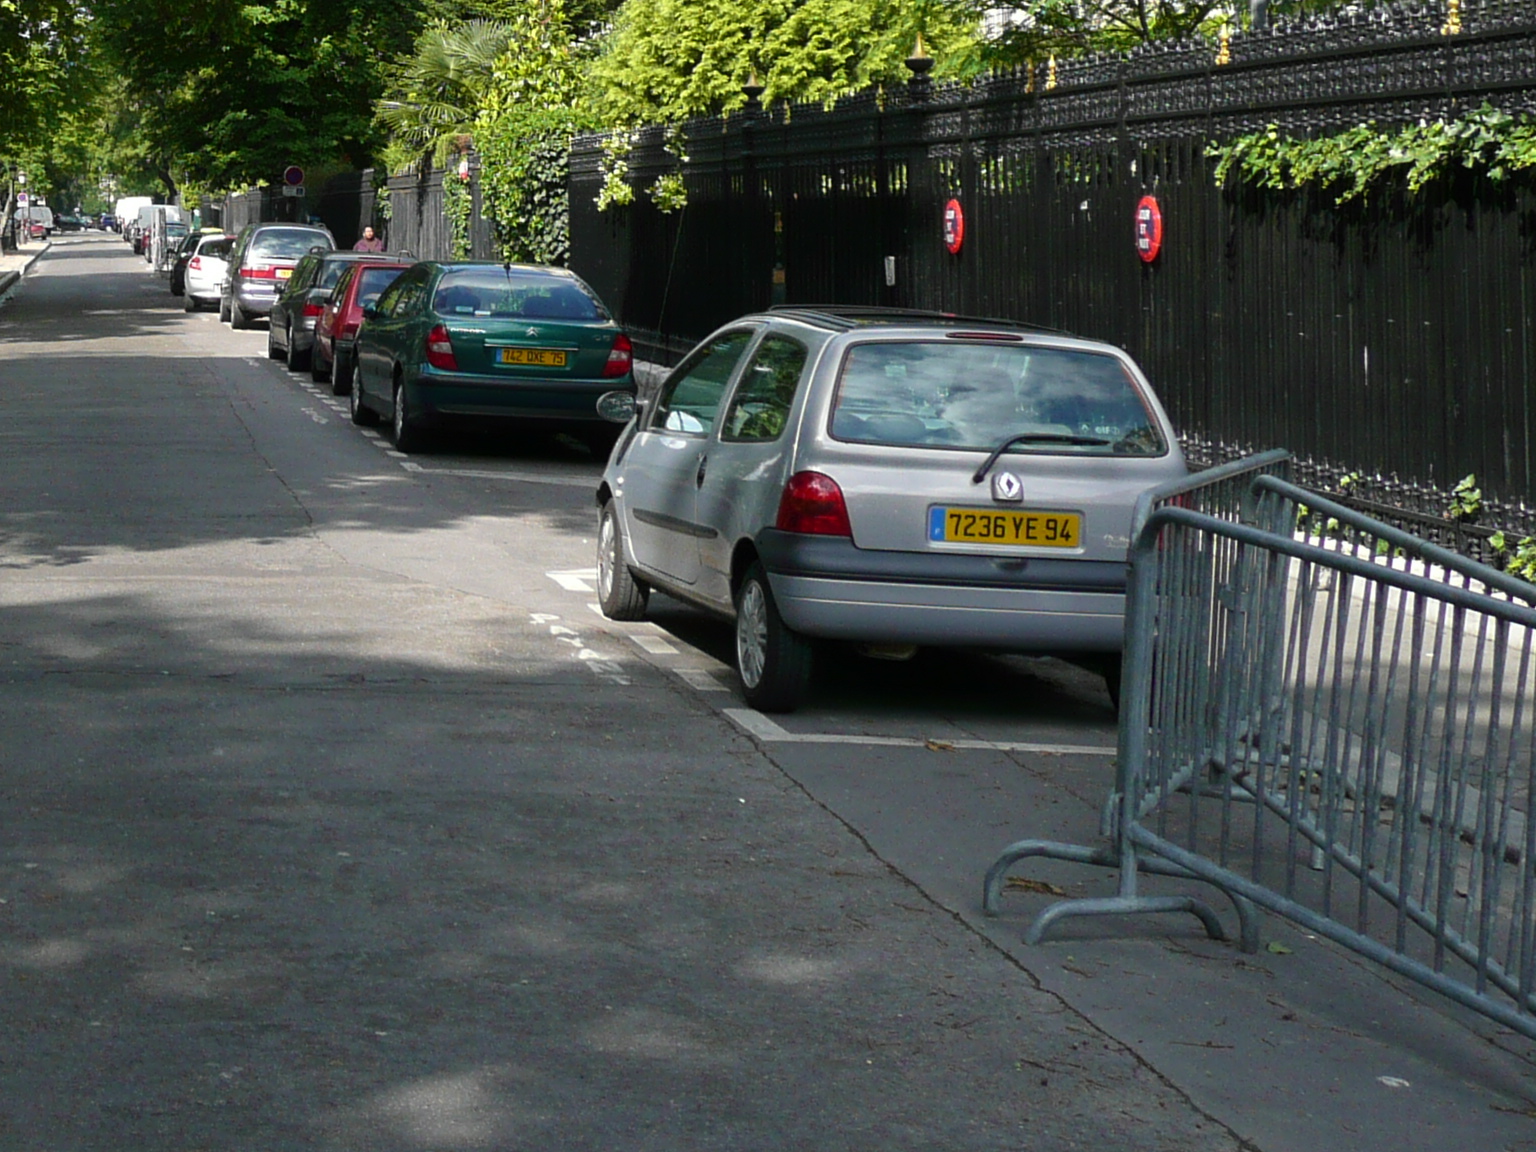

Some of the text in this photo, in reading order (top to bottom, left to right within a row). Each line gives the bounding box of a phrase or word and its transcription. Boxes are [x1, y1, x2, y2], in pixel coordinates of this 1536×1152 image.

[504, 349, 523, 363] 742
[551, 352, 564, 365] 75
[949, 514, 1072, 541] 7236 YE 94
